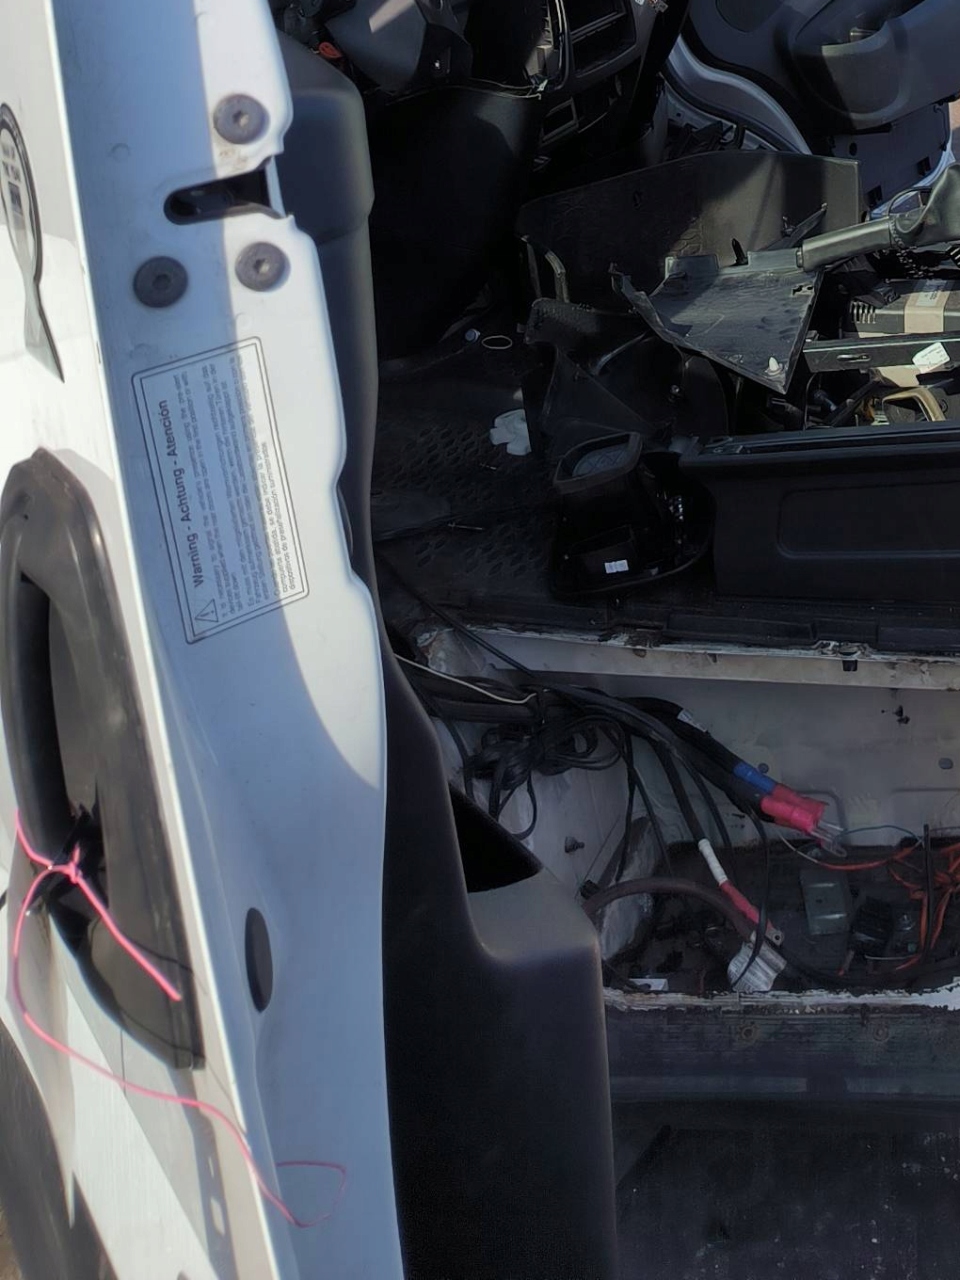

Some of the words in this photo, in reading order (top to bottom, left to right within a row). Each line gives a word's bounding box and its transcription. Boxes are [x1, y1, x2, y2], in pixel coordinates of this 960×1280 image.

[158, 400, 177, 457] Atención
[172, 468, 190, 522] Achtung
[187, 532, 204, 588] Warning
